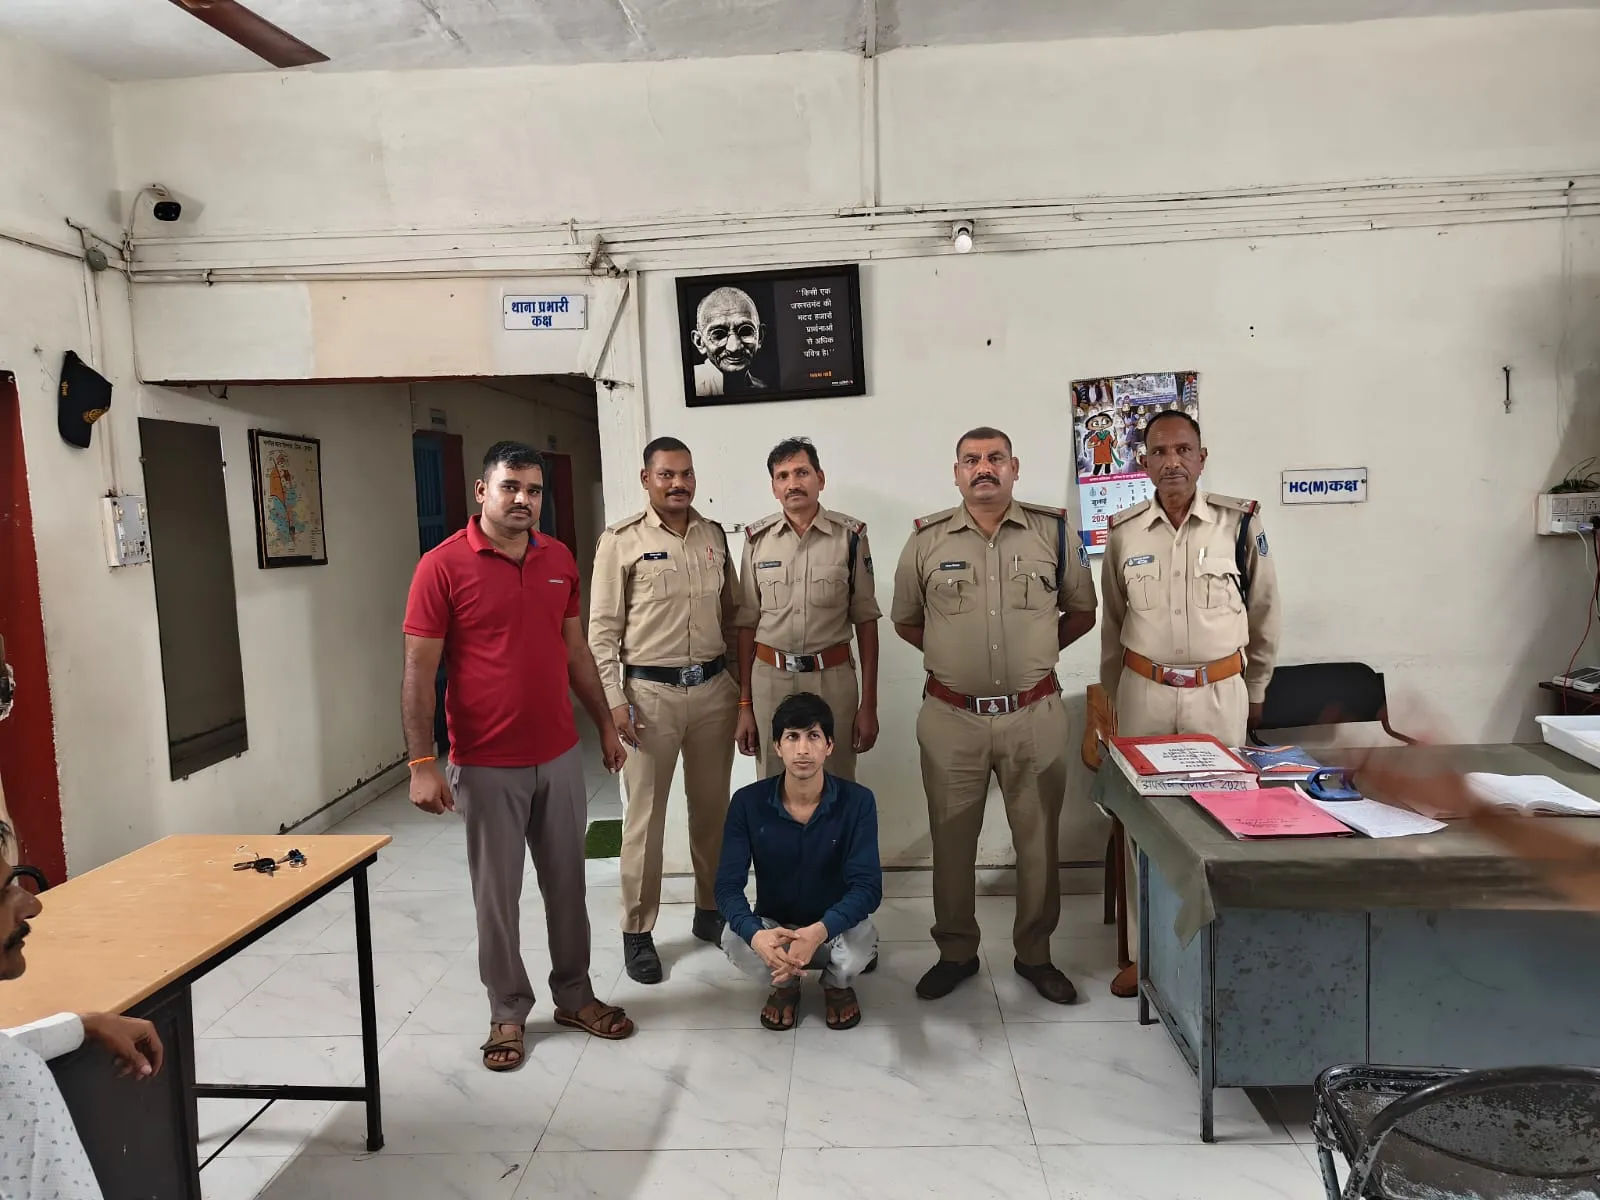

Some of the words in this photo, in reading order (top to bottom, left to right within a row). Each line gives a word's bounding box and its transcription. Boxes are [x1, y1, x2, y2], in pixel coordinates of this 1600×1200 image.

[511, 301, 536, 313] थाना
[538, 296, 569, 313] प्रभारी
[823, 298, 832, 307] की
[531, 315, 552, 327] कक्ष
